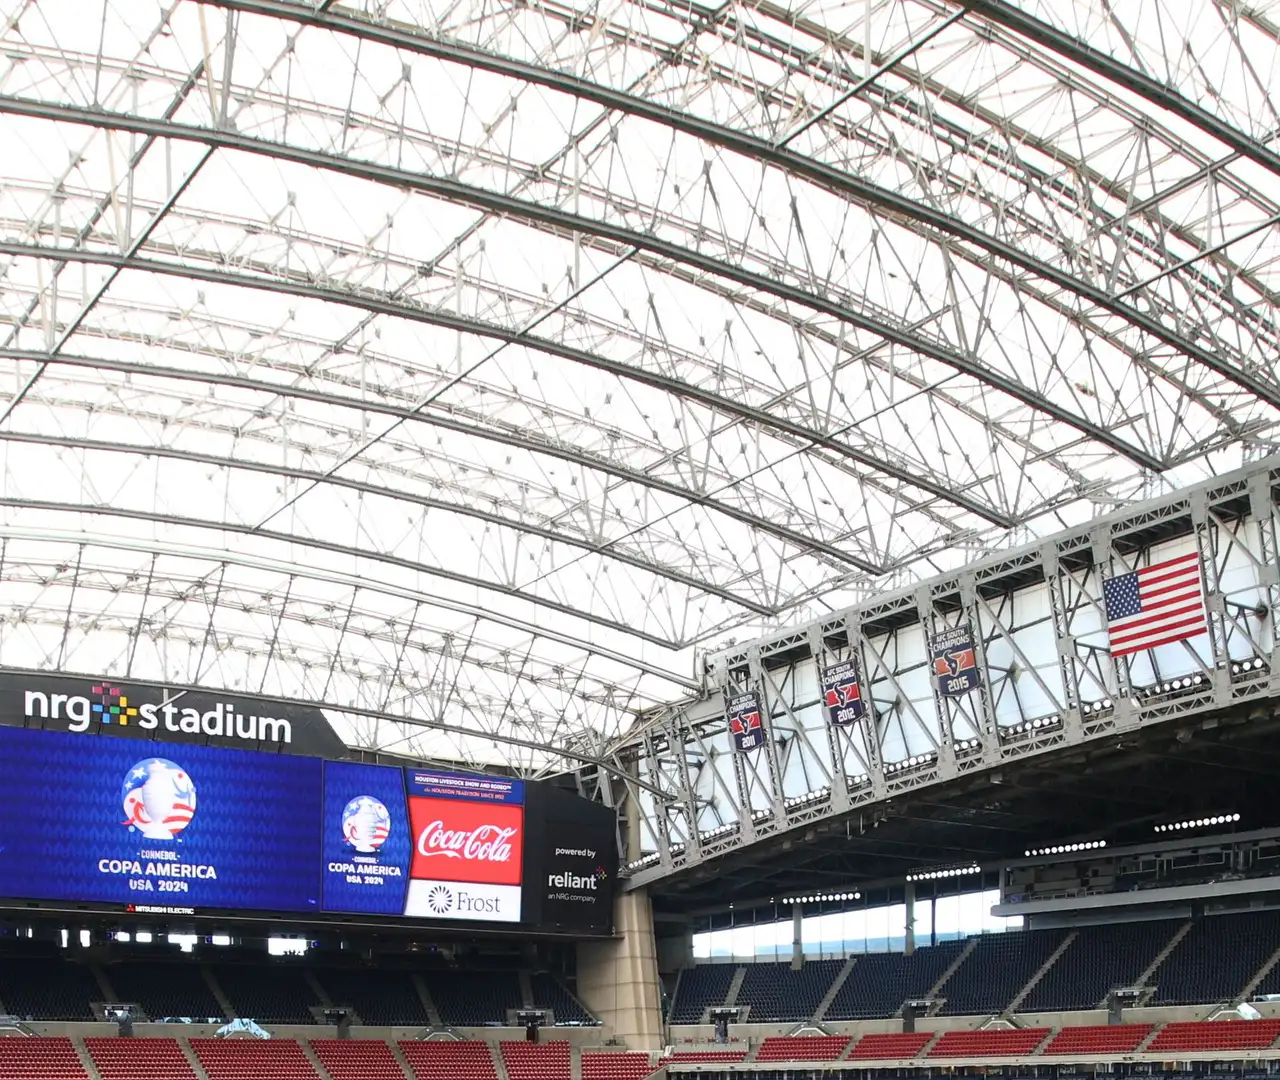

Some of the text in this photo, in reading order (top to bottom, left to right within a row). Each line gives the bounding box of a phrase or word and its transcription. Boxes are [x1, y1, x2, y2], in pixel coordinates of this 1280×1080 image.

[946, 628, 965, 638] SOUTH
[933, 634, 970, 652] CHAMPIONS
[825, 670, 855, 685] CHAMPIONS
[947, 675, 970, 692] 2015
[24, 688, 291, 743] nrg stadium
[837, 707, 855, 722] 2012
[741, 734, 755, 748] 2011
[439, 778, 464, 786] LIVESTOCK
[555, 848, 596, 859] powered by
[98, 859, 217, 879] COPA AMERICA
[328, 862, 401, 876] COPA AMERICA
[129, 879, 188, 893] USA 2024
[346, 875, 384, 885] USA 2024
[548, 872, 597, 890] reliant
[457, 892, 501, 912] Frost
[570, 895, 596, 904] company
[135, 905, 194, 915] MITSUBISHI ELECTRIC
